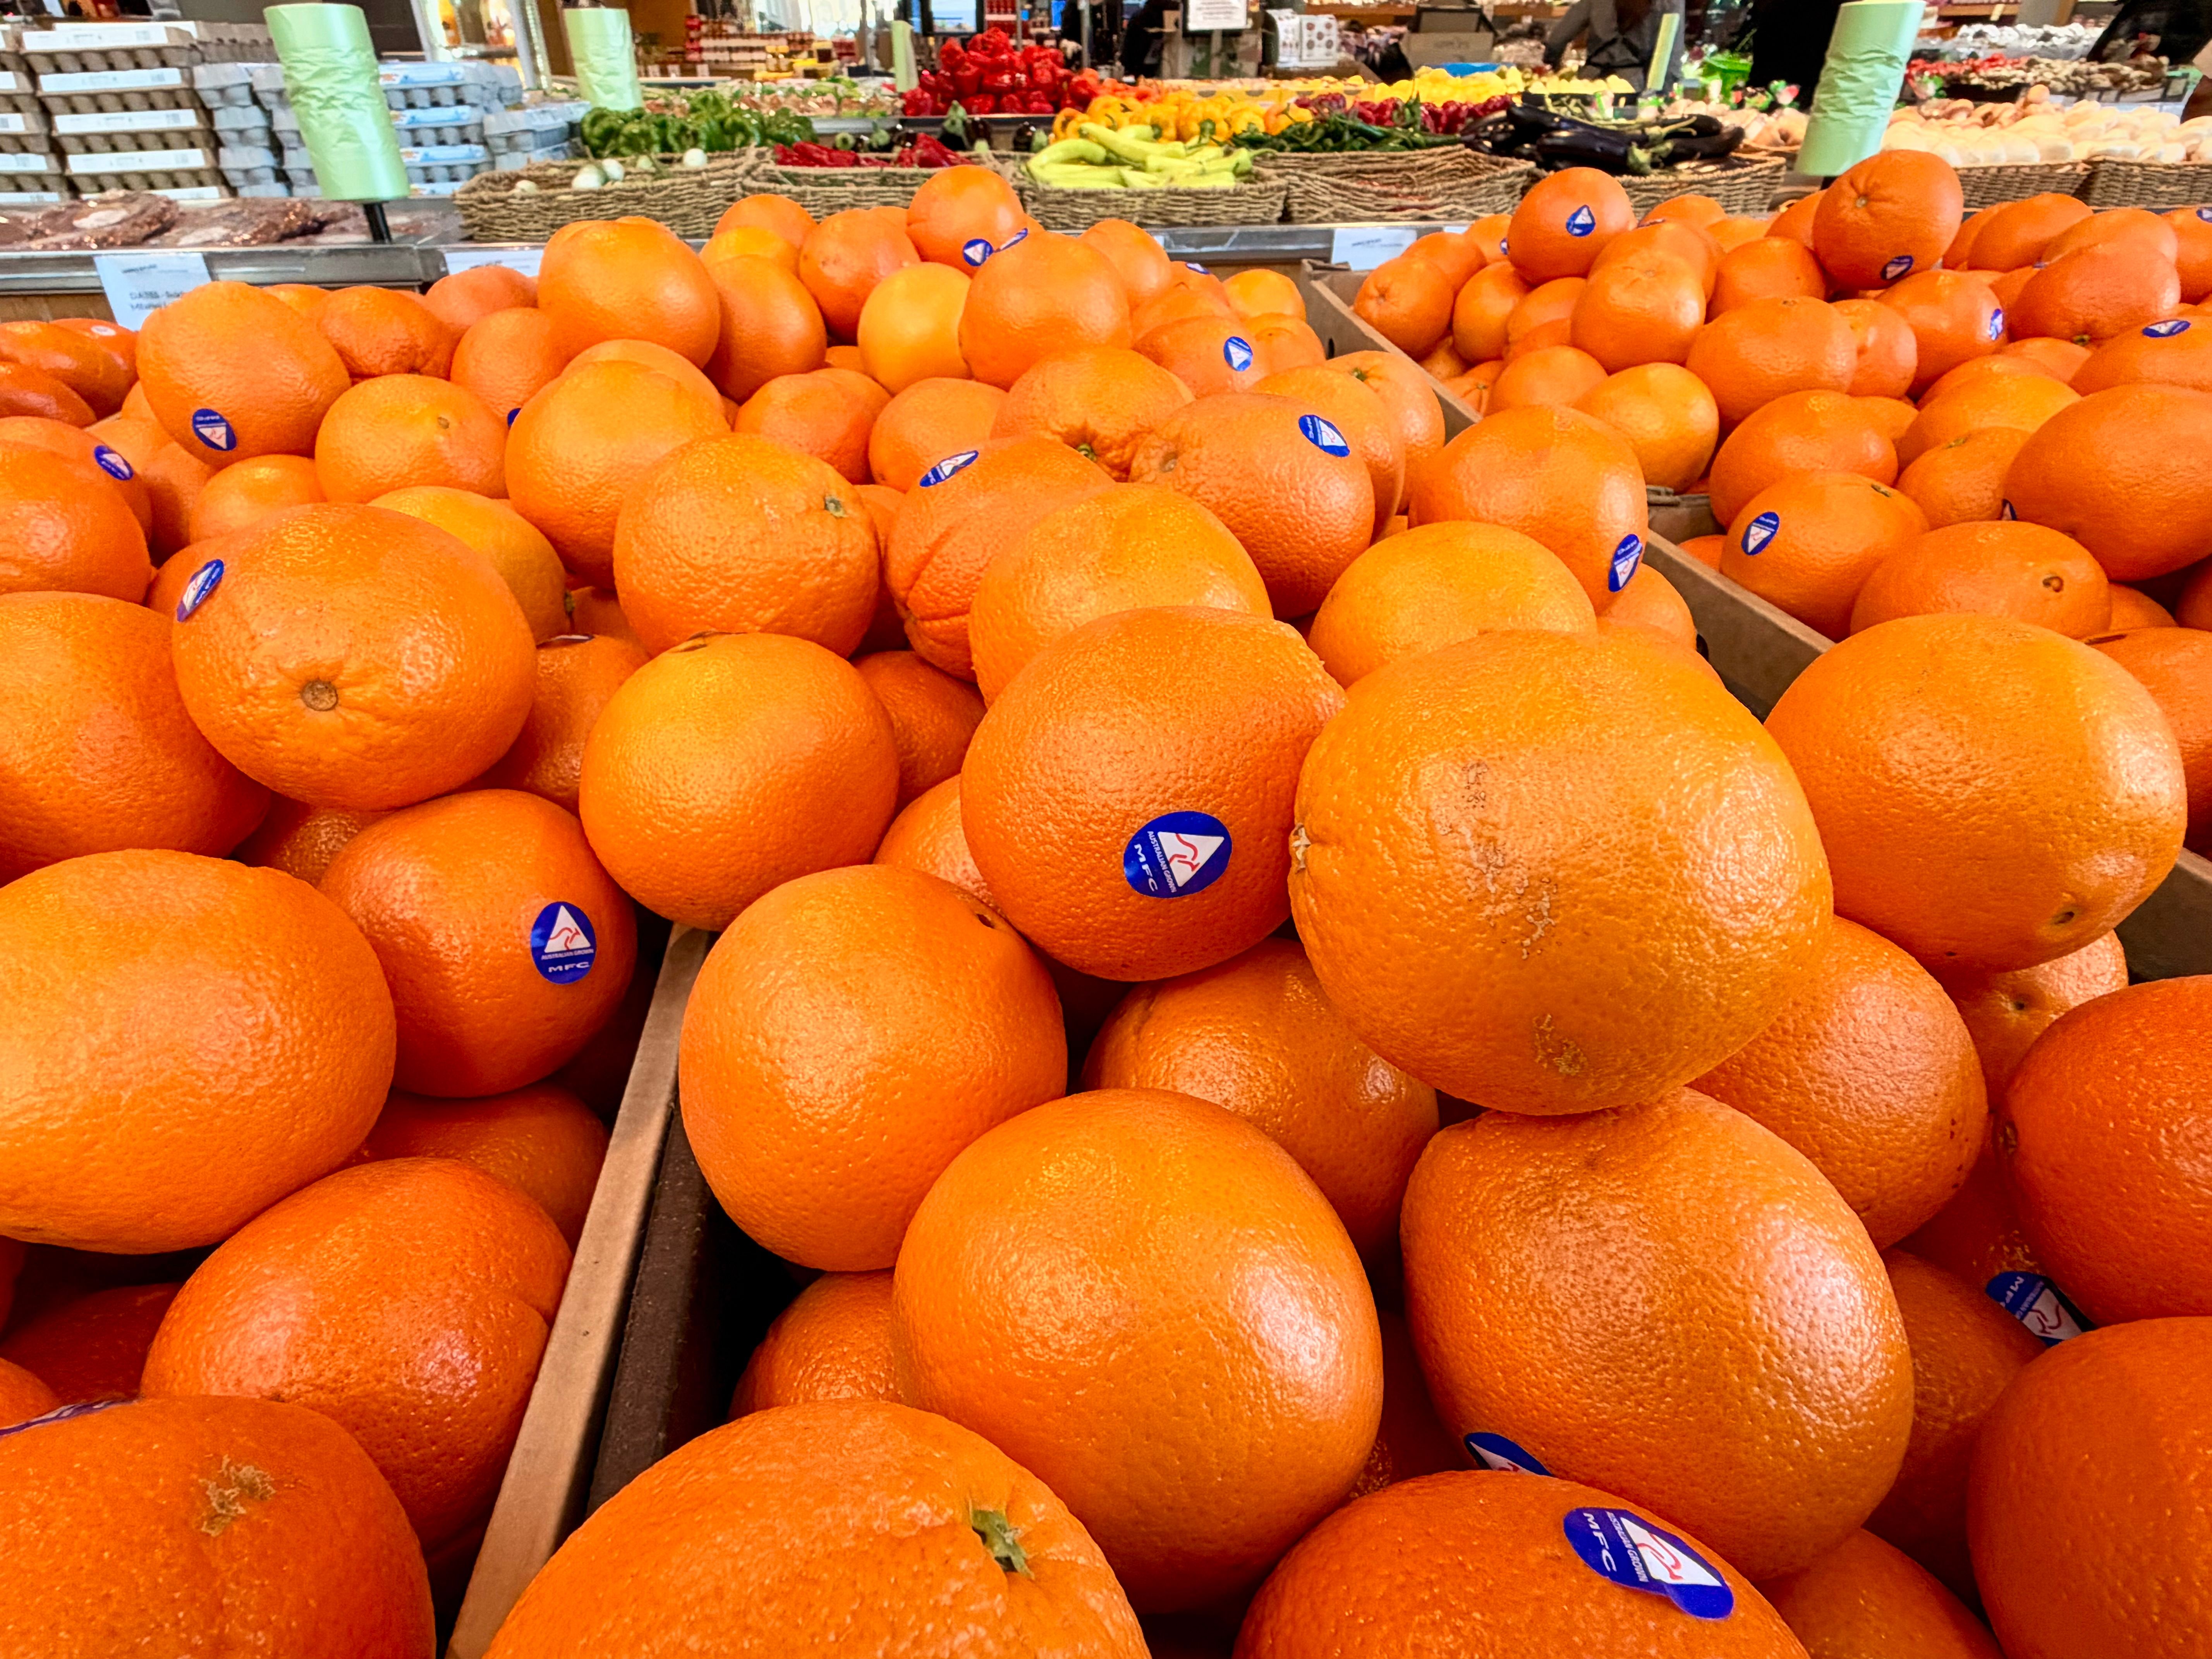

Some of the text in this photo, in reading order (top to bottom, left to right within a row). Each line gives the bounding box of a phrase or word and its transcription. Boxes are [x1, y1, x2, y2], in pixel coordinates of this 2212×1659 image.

[1134, 843, 1158, 892] MFC
[1147, 831, 1178, 893] AUSTRALIAN GROWN
[548, 962, 590, 973] MFC
[1583, 1512, 1617, 1572] MFC
[1627, 1547, 1649, 1583] GROWN
